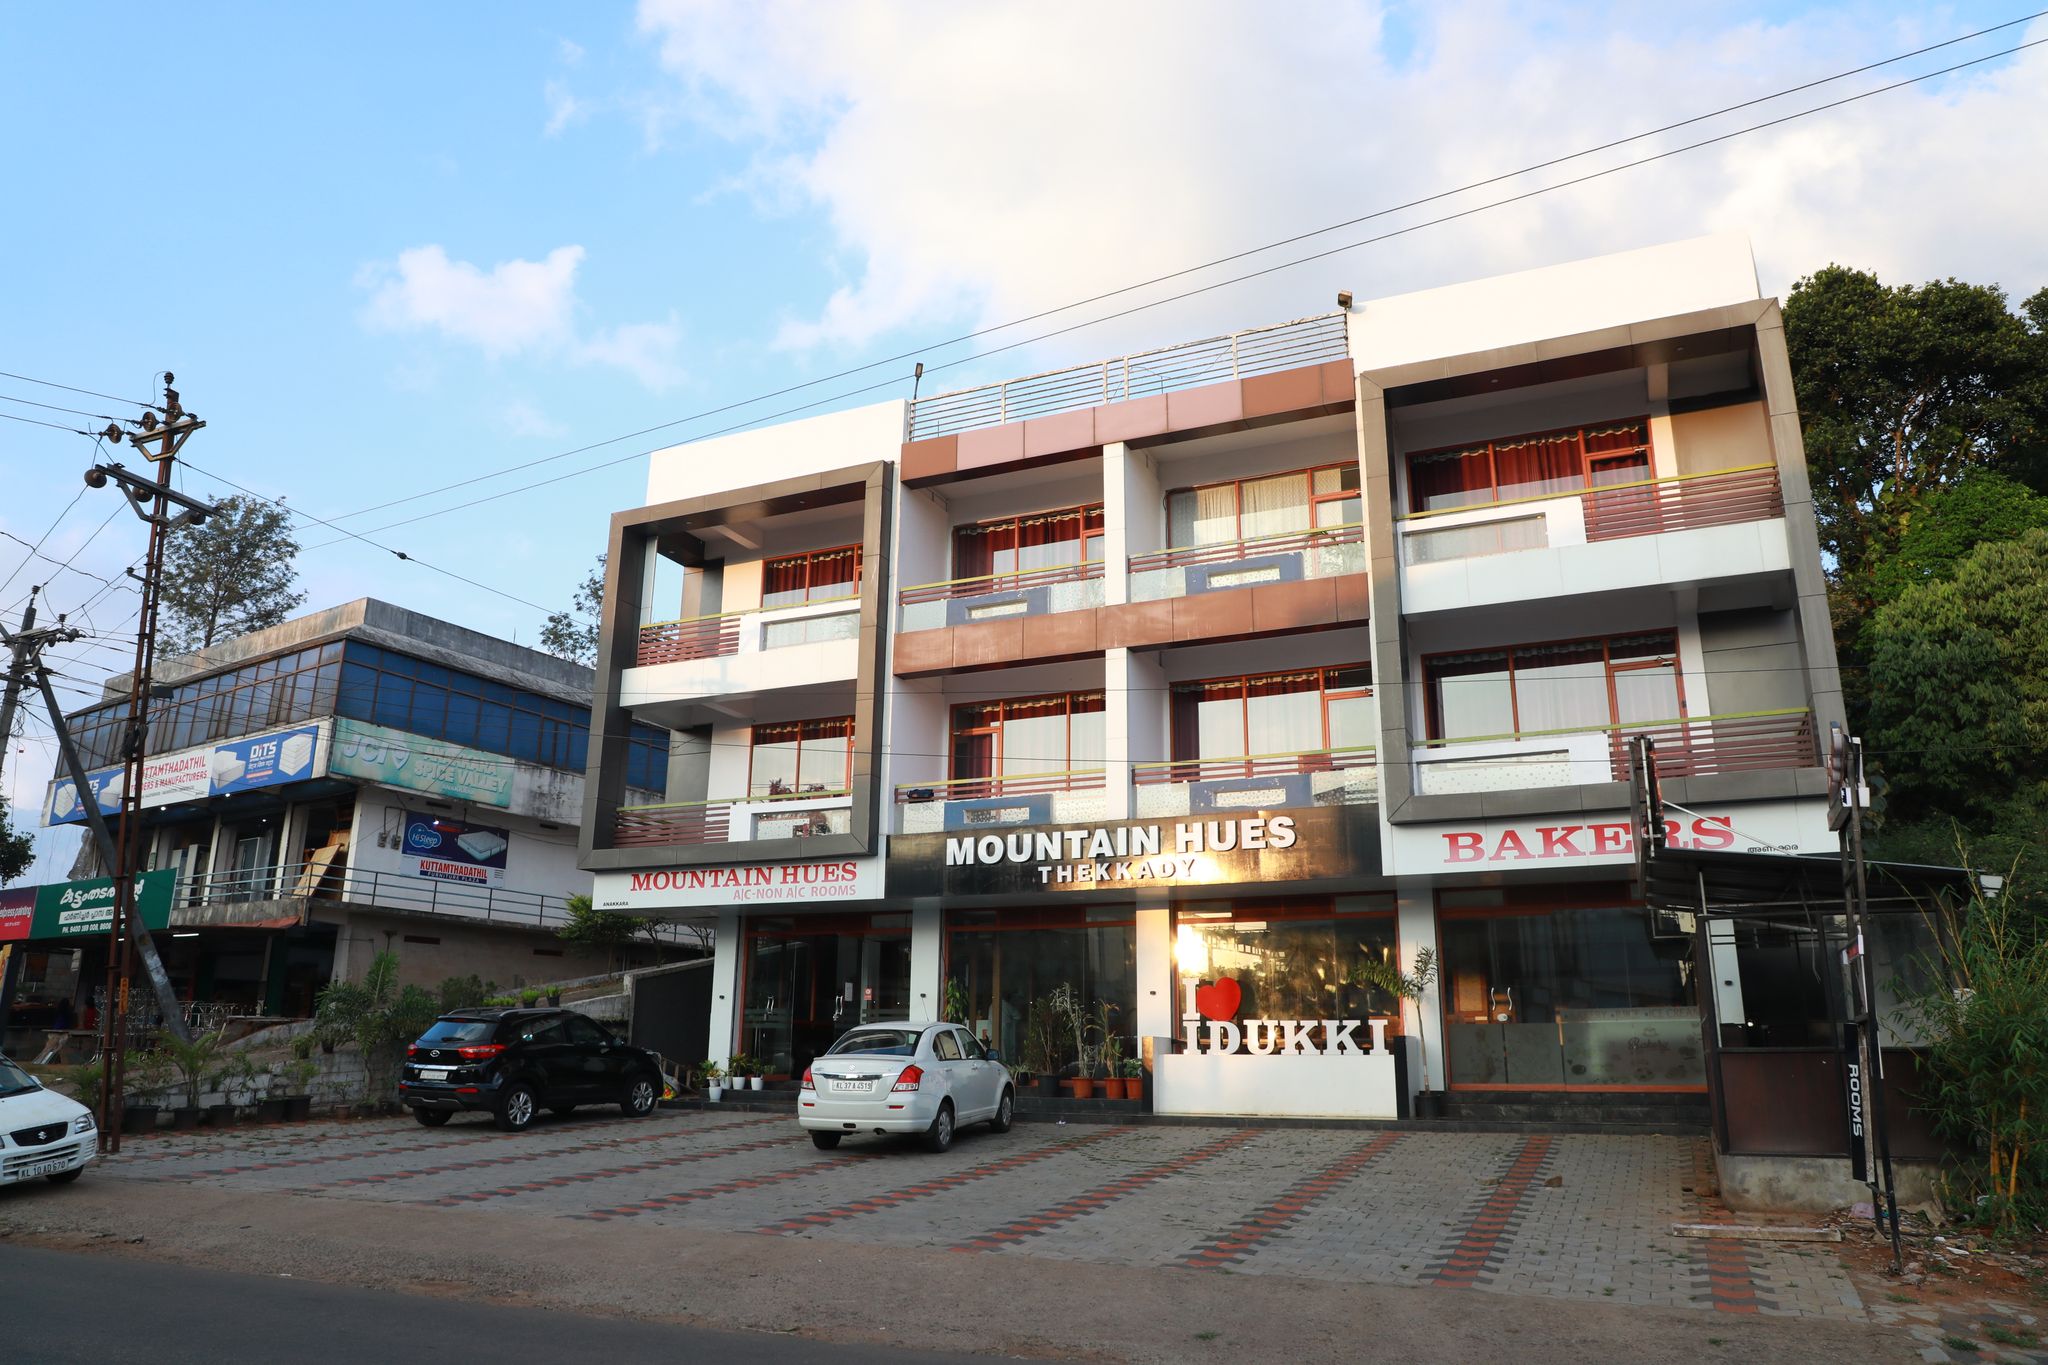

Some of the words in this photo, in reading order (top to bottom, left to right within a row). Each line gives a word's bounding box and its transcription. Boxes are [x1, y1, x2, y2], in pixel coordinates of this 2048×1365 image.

[343, 735, 389, 765] JCI
[414, 760, 455, 783] SPICE
[946, 825, 1160, 866] MOUNTAIN
[1176, 816, 1297, 853] HUES
[420, 860, 488, 879] KUTTAMTHADATHIL
[428, 872, 459, 881] FURNITURE
[461, 876, 480, 884] PLAZA
[631, 867, 774, 892] MOUNTAIN
[780, 861, 858, 885] HUES
[1038, 858, 1196, 885] THEKKADY
[811, 884, 857, 897] ROOMS
[1182, 977, 1201, 1021] I
[1183, 1019, 1390, 1056] IDUKKI
[1848, 1063, 1863, 1138] ROOMS
[21, 1169, 31, 1178] KL
